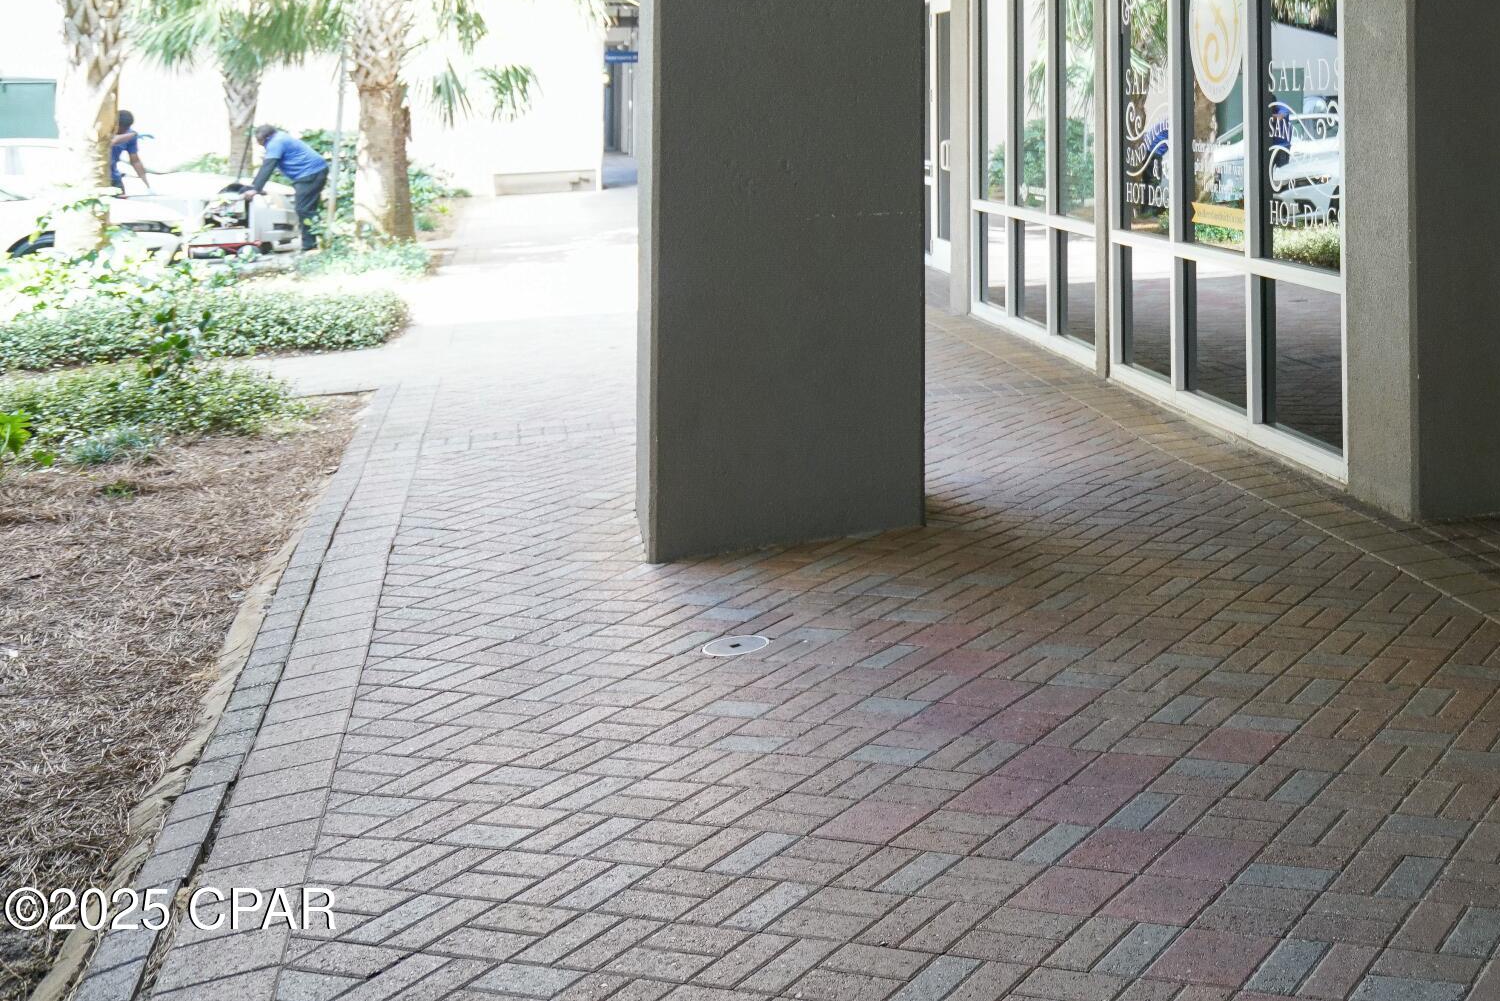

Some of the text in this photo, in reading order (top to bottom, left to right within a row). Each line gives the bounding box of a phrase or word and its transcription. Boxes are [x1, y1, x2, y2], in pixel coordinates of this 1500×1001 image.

[1125, 68, 1168, 95] SAL
[1126, 183, 1146, 204] HOT
[1269, 200, 1299, 228] HOT
